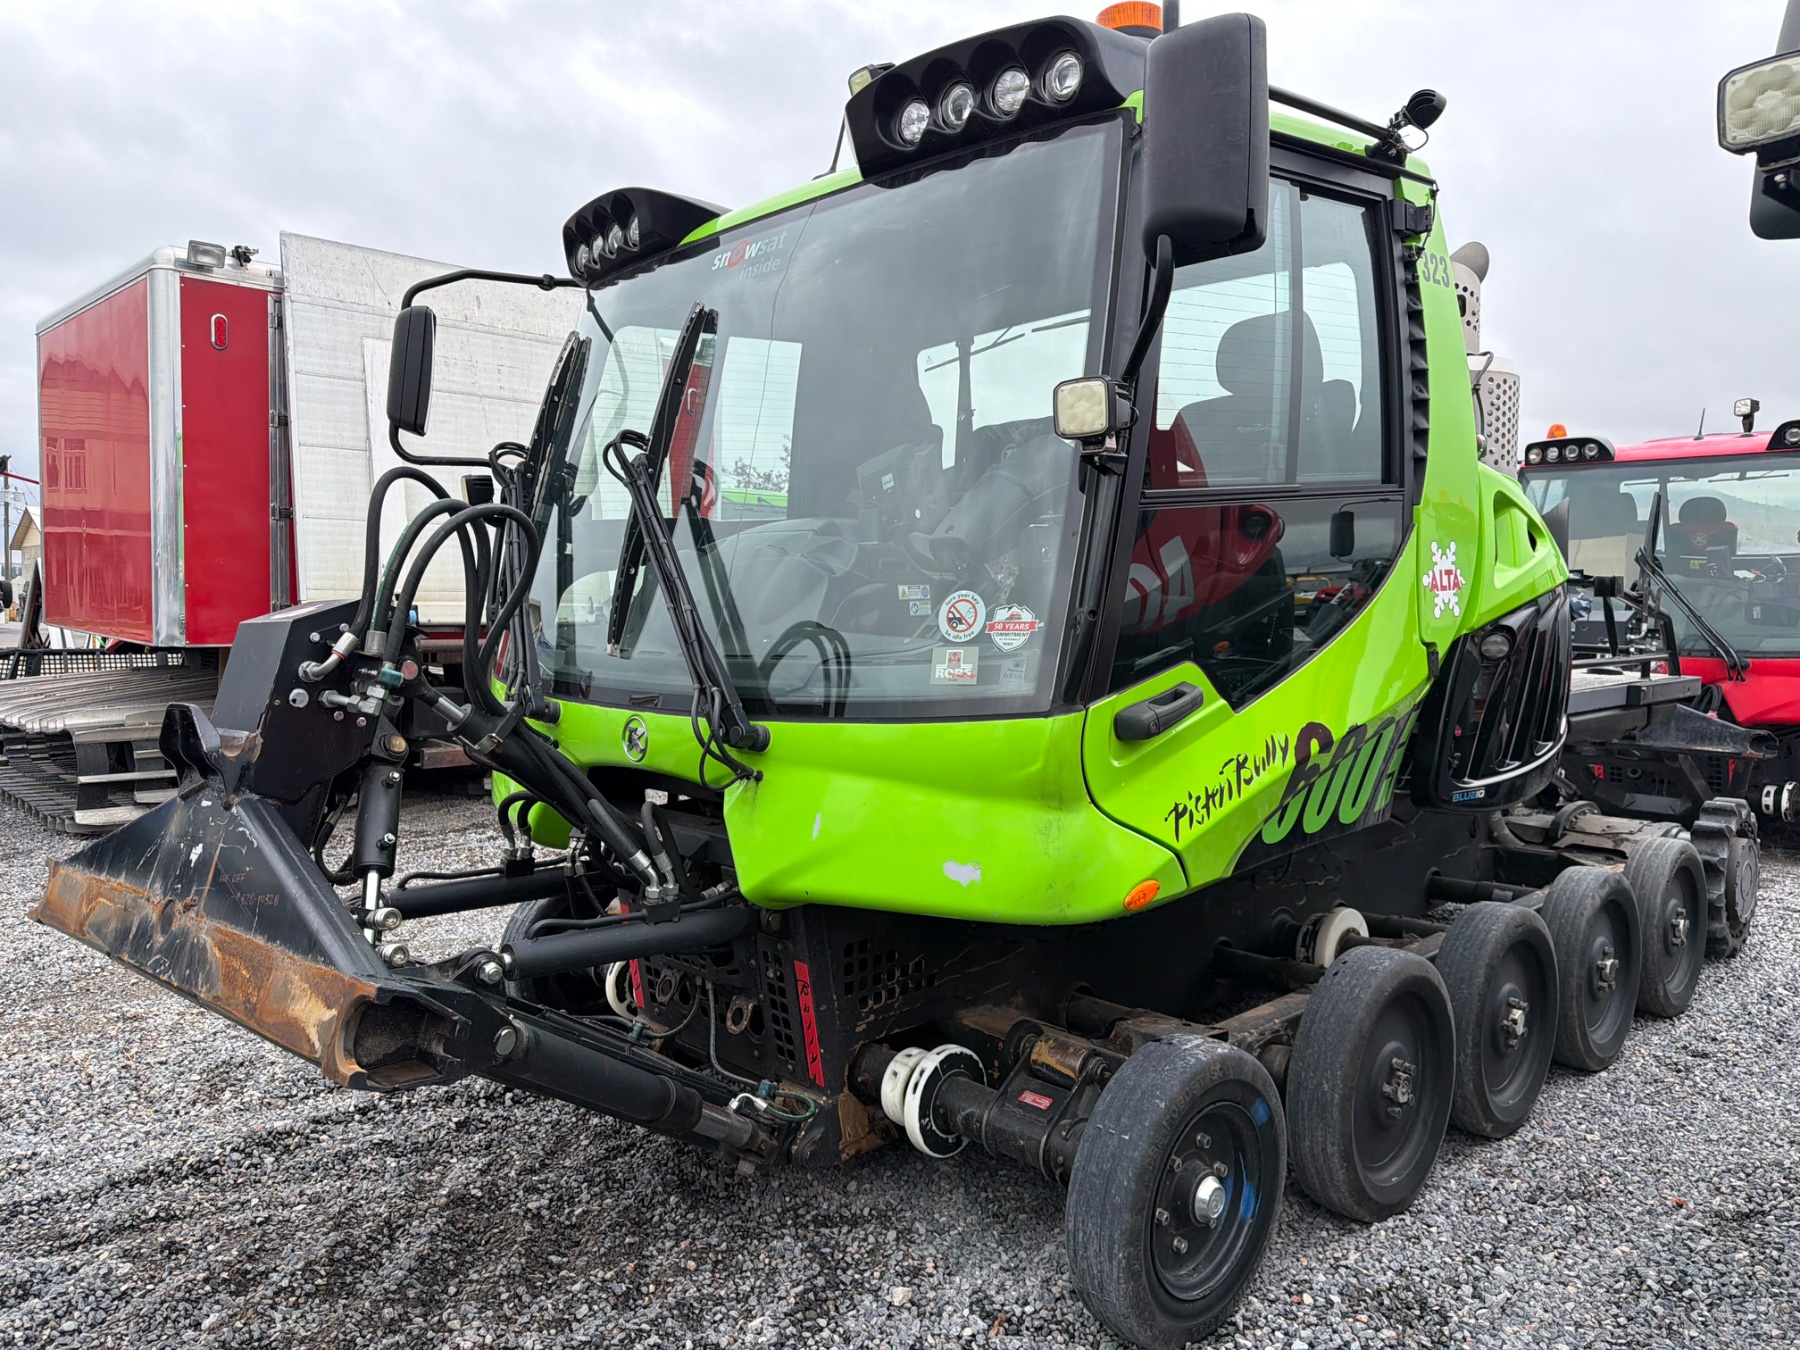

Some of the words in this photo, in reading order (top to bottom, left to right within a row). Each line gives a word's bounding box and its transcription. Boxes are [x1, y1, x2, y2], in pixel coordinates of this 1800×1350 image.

[712, 231, 787, 270] snowsat
[740, 256, 780, 279] inside
[1421, 252, 1450, 288] 323
[1430, 569, 1461, 592] ALTA
[945, 595, 956, 606] turn
[957, 592, 970, 600] your
[971, 594, 980, 605] key
[952, 632, 962, 640] idle
[963, 630, 975, 639] free
[1164, 734, 1289, 843] PistenBully
